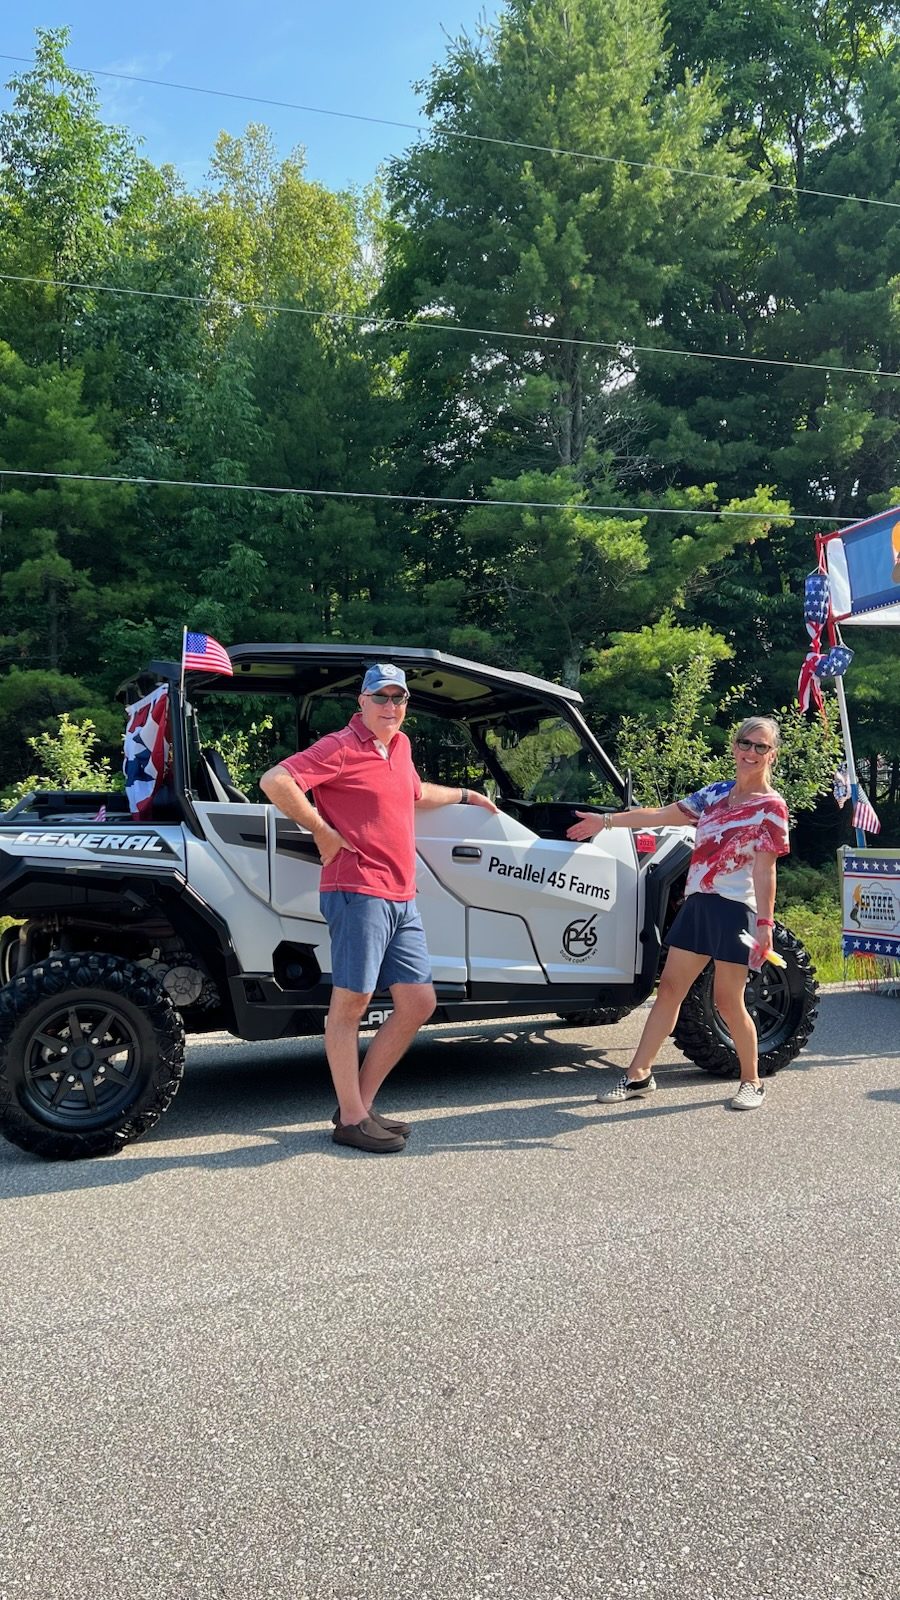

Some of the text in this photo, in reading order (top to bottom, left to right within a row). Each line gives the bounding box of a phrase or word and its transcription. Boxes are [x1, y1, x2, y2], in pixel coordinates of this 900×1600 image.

[13, 832, 163, 852] GENERAL
[488, 856, 610, 900] Parallel 45 Farms
[861, 894, 893, 908] COYOTE
